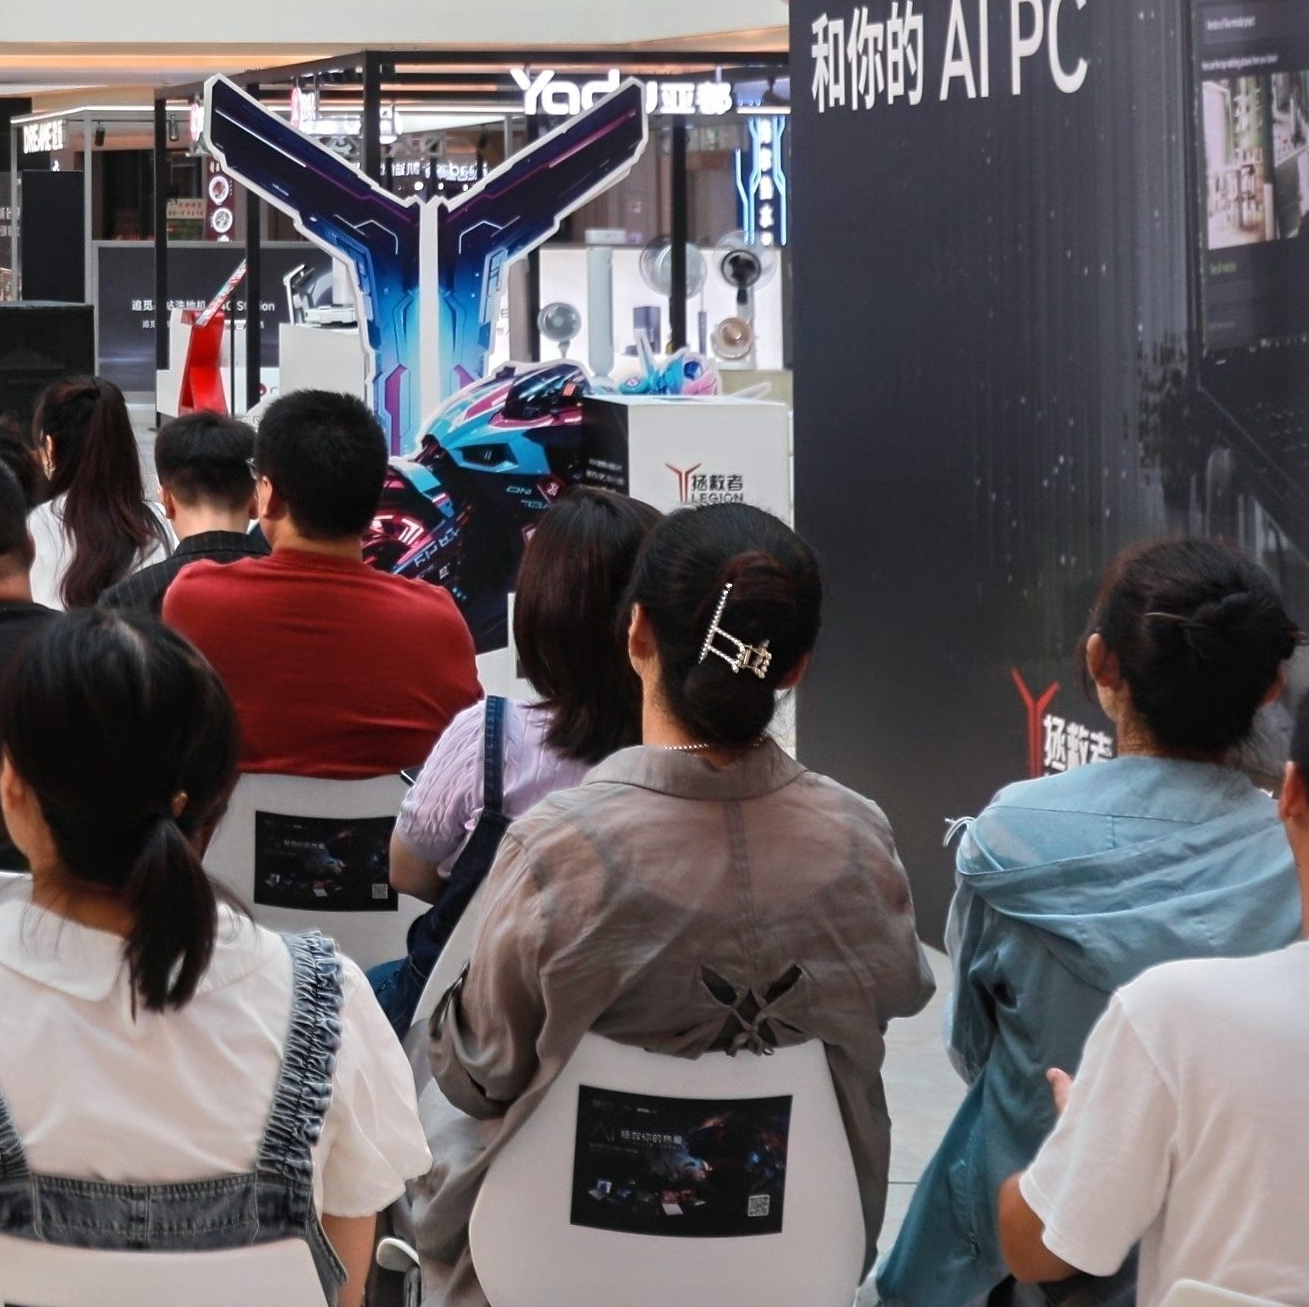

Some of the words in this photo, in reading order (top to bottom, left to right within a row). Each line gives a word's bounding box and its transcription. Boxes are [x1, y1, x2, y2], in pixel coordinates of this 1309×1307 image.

[659, 82, 733, 115] 亚都
[691, 474, 743, 492] 拯救者
